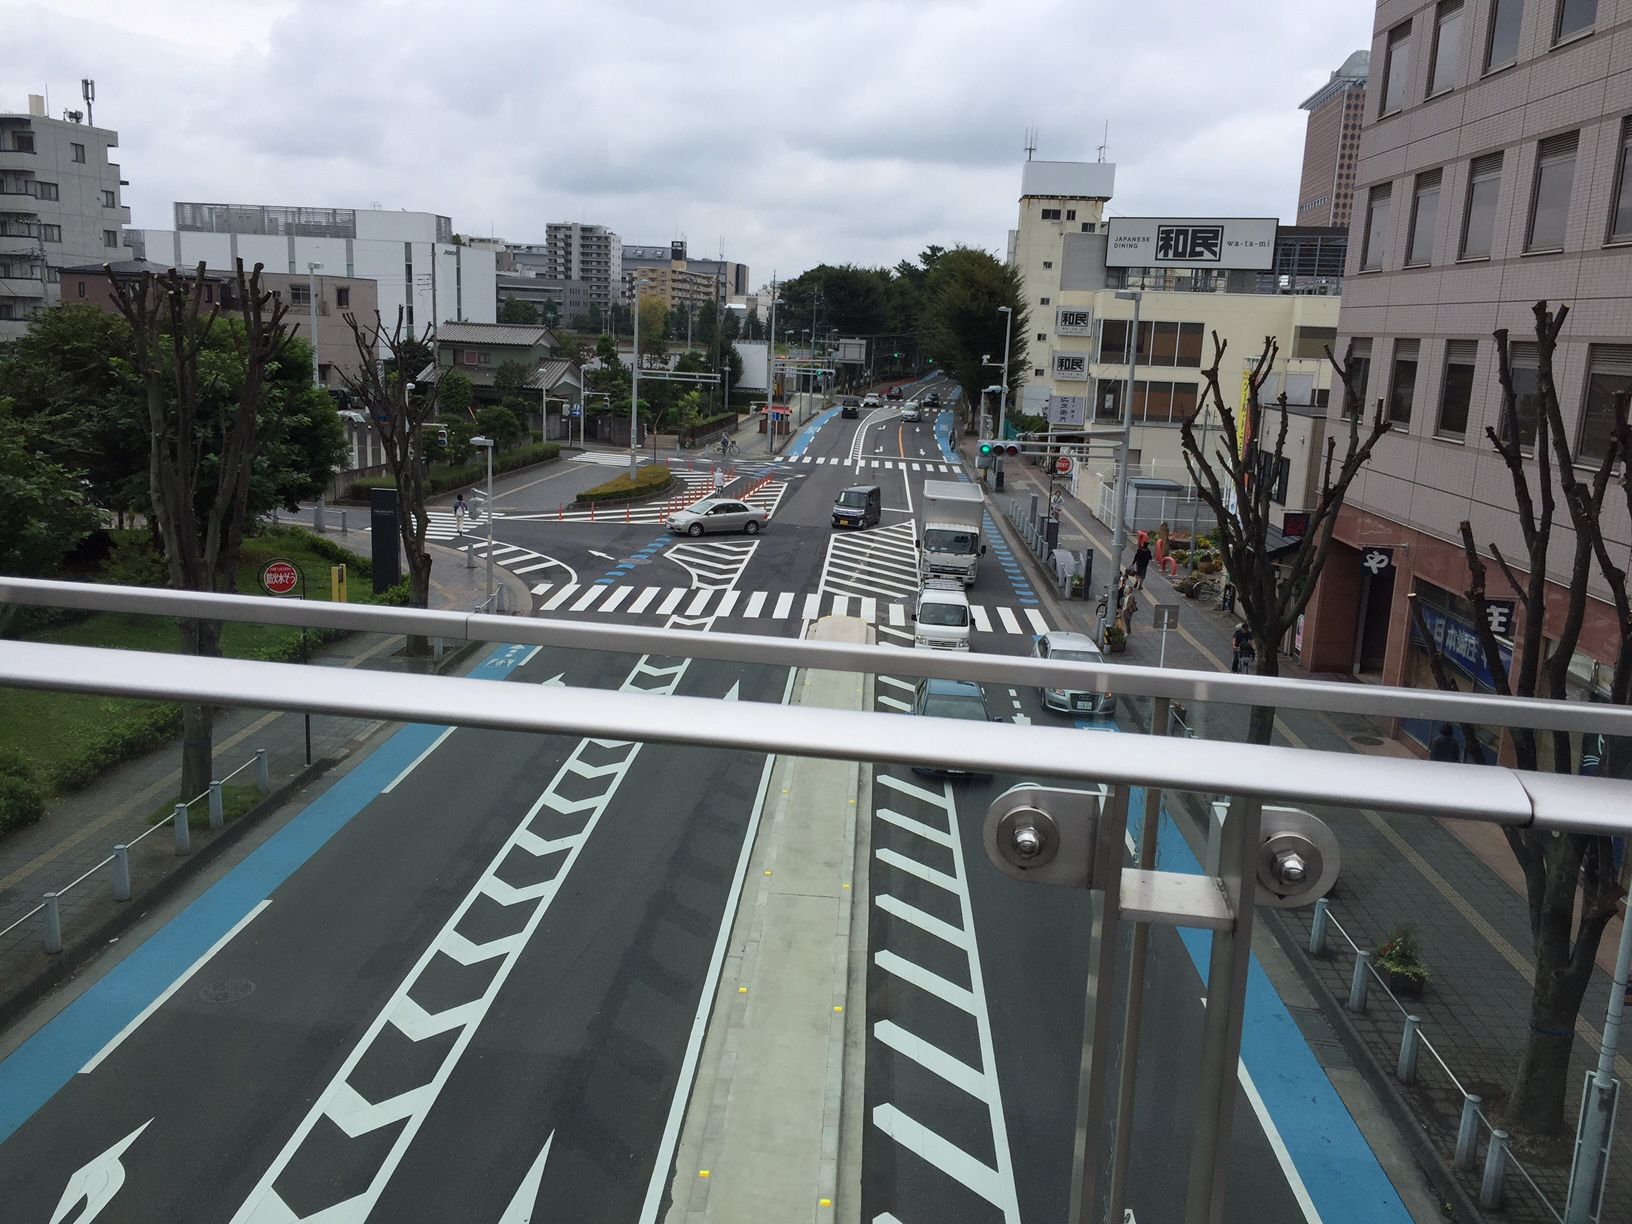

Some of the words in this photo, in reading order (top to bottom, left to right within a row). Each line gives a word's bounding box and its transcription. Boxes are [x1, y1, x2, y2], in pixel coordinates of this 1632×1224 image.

[1159, 228, 1220, 258] 和民
[1227, 239, 1271, 247] wa-ta-mi
[1062, 313, 1087, 325] 和民
[1058, 358, 1083, 370] 和民
